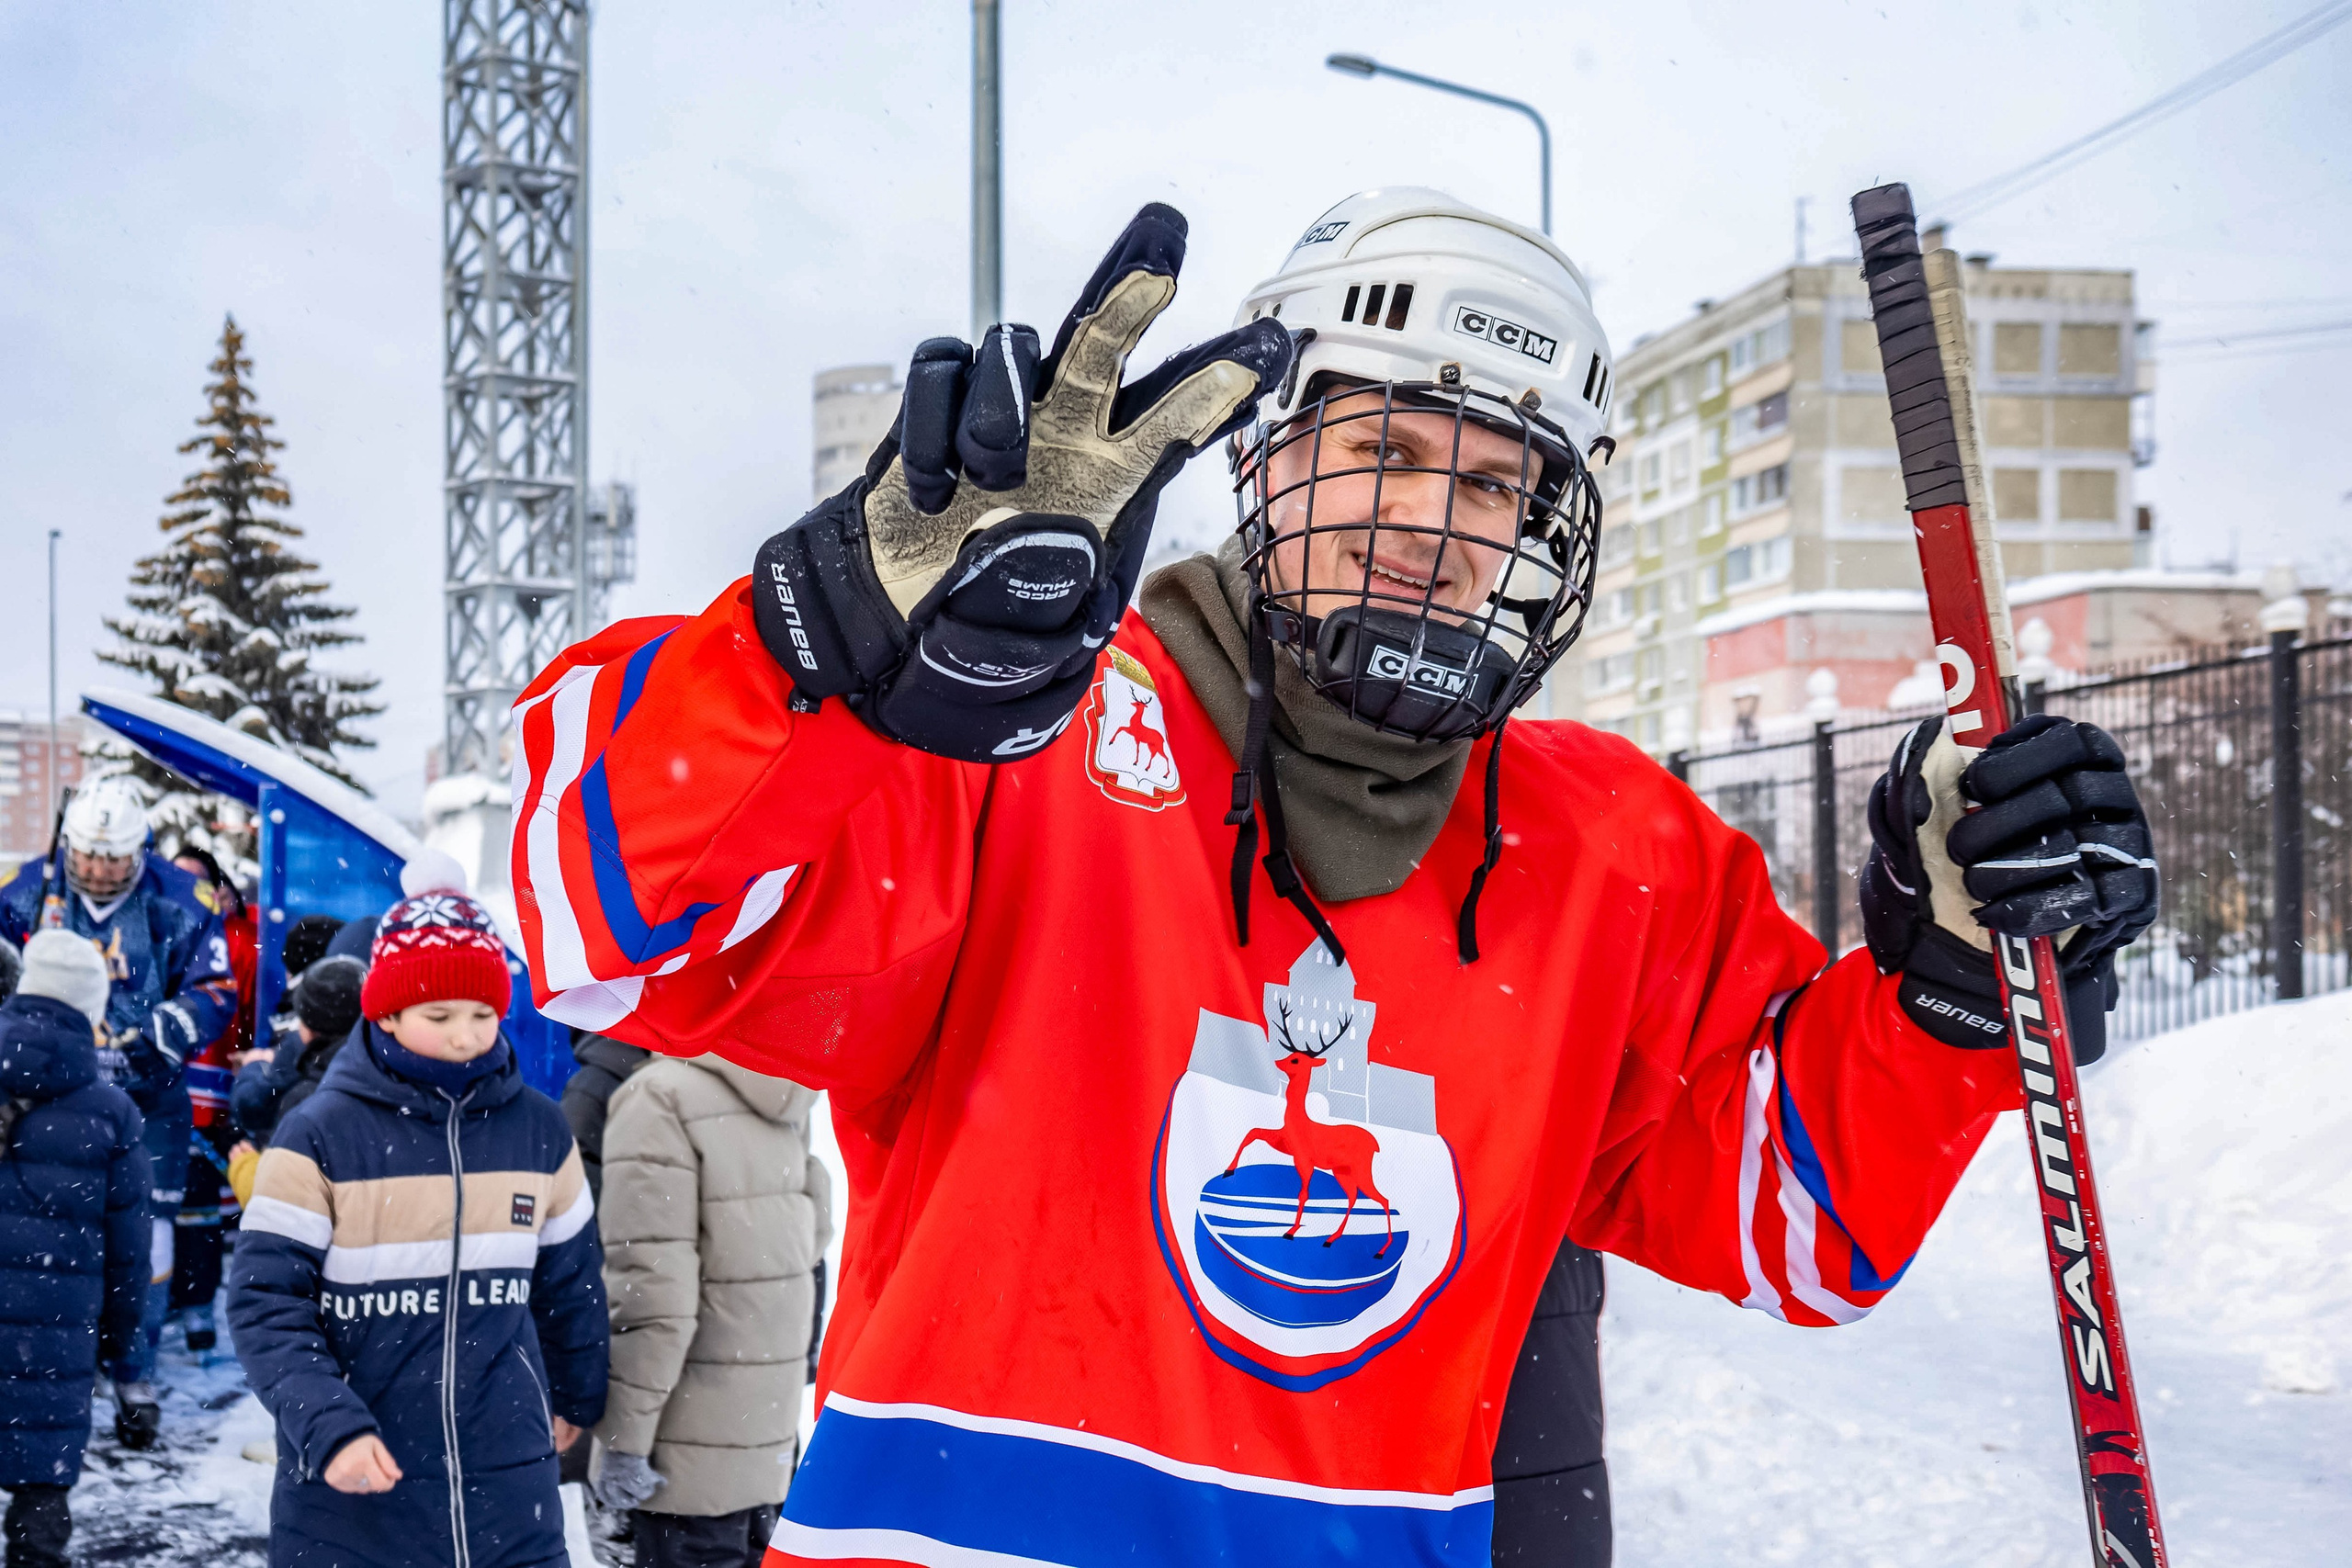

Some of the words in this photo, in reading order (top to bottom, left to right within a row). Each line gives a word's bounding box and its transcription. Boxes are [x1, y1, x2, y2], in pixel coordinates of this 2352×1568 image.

[1459, 312, 1555, 362] CCM
[1008, 578, 1077, 592] THUMB
[1376, 653, 1473, 697] CCM
[100, 810, 110, 827] 3
[209, 936, 229, 972] 3
[1999, 933, 2113, 1393] SALMING
[321, 1288, 440, 1320] FUTURE
[468, 1278, 530, 1306] LEAD
